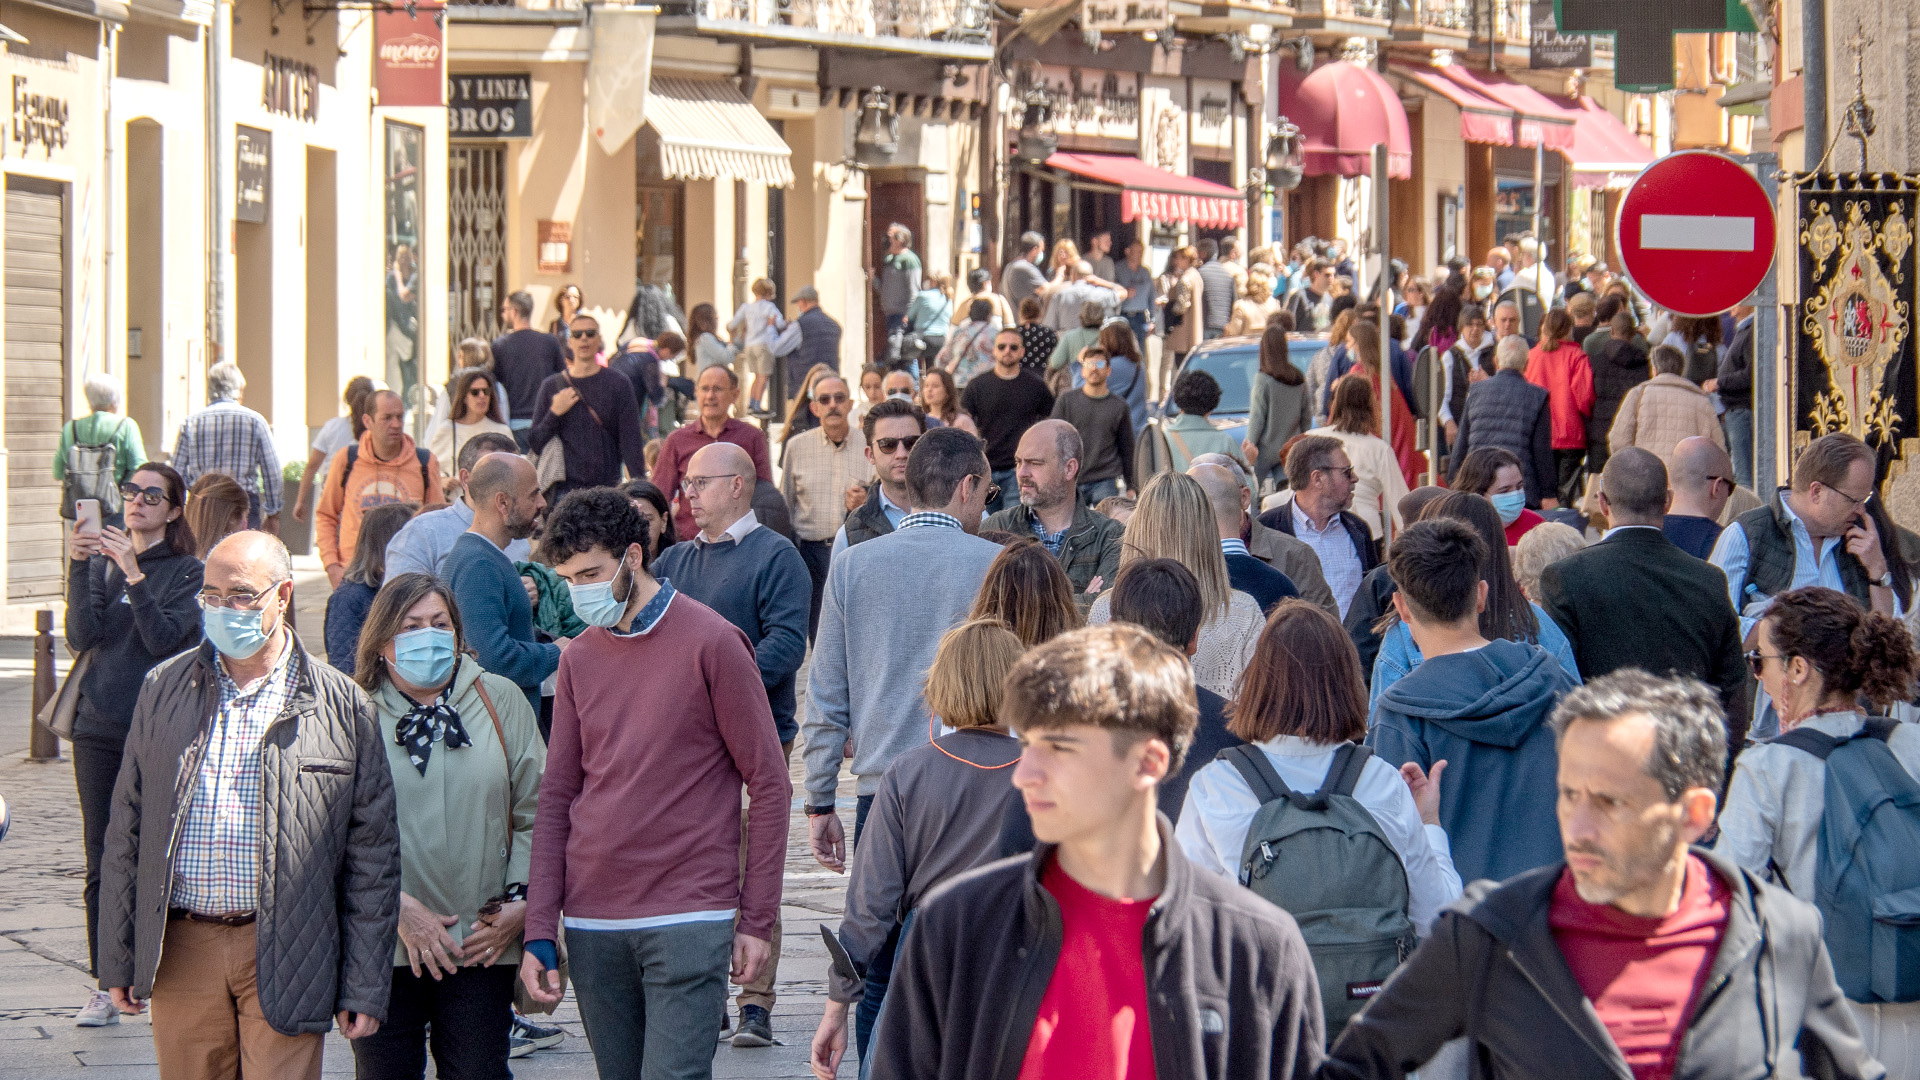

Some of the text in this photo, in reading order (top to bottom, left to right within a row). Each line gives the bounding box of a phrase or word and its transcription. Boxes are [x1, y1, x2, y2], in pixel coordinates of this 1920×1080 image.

[1533, 30, 1587, 46] PLAZA
[459, 79, 472, 100] Y
[477, 78, 529, 100] LINEA
[1130, 191, 1240, 223] RESTAURANTE
